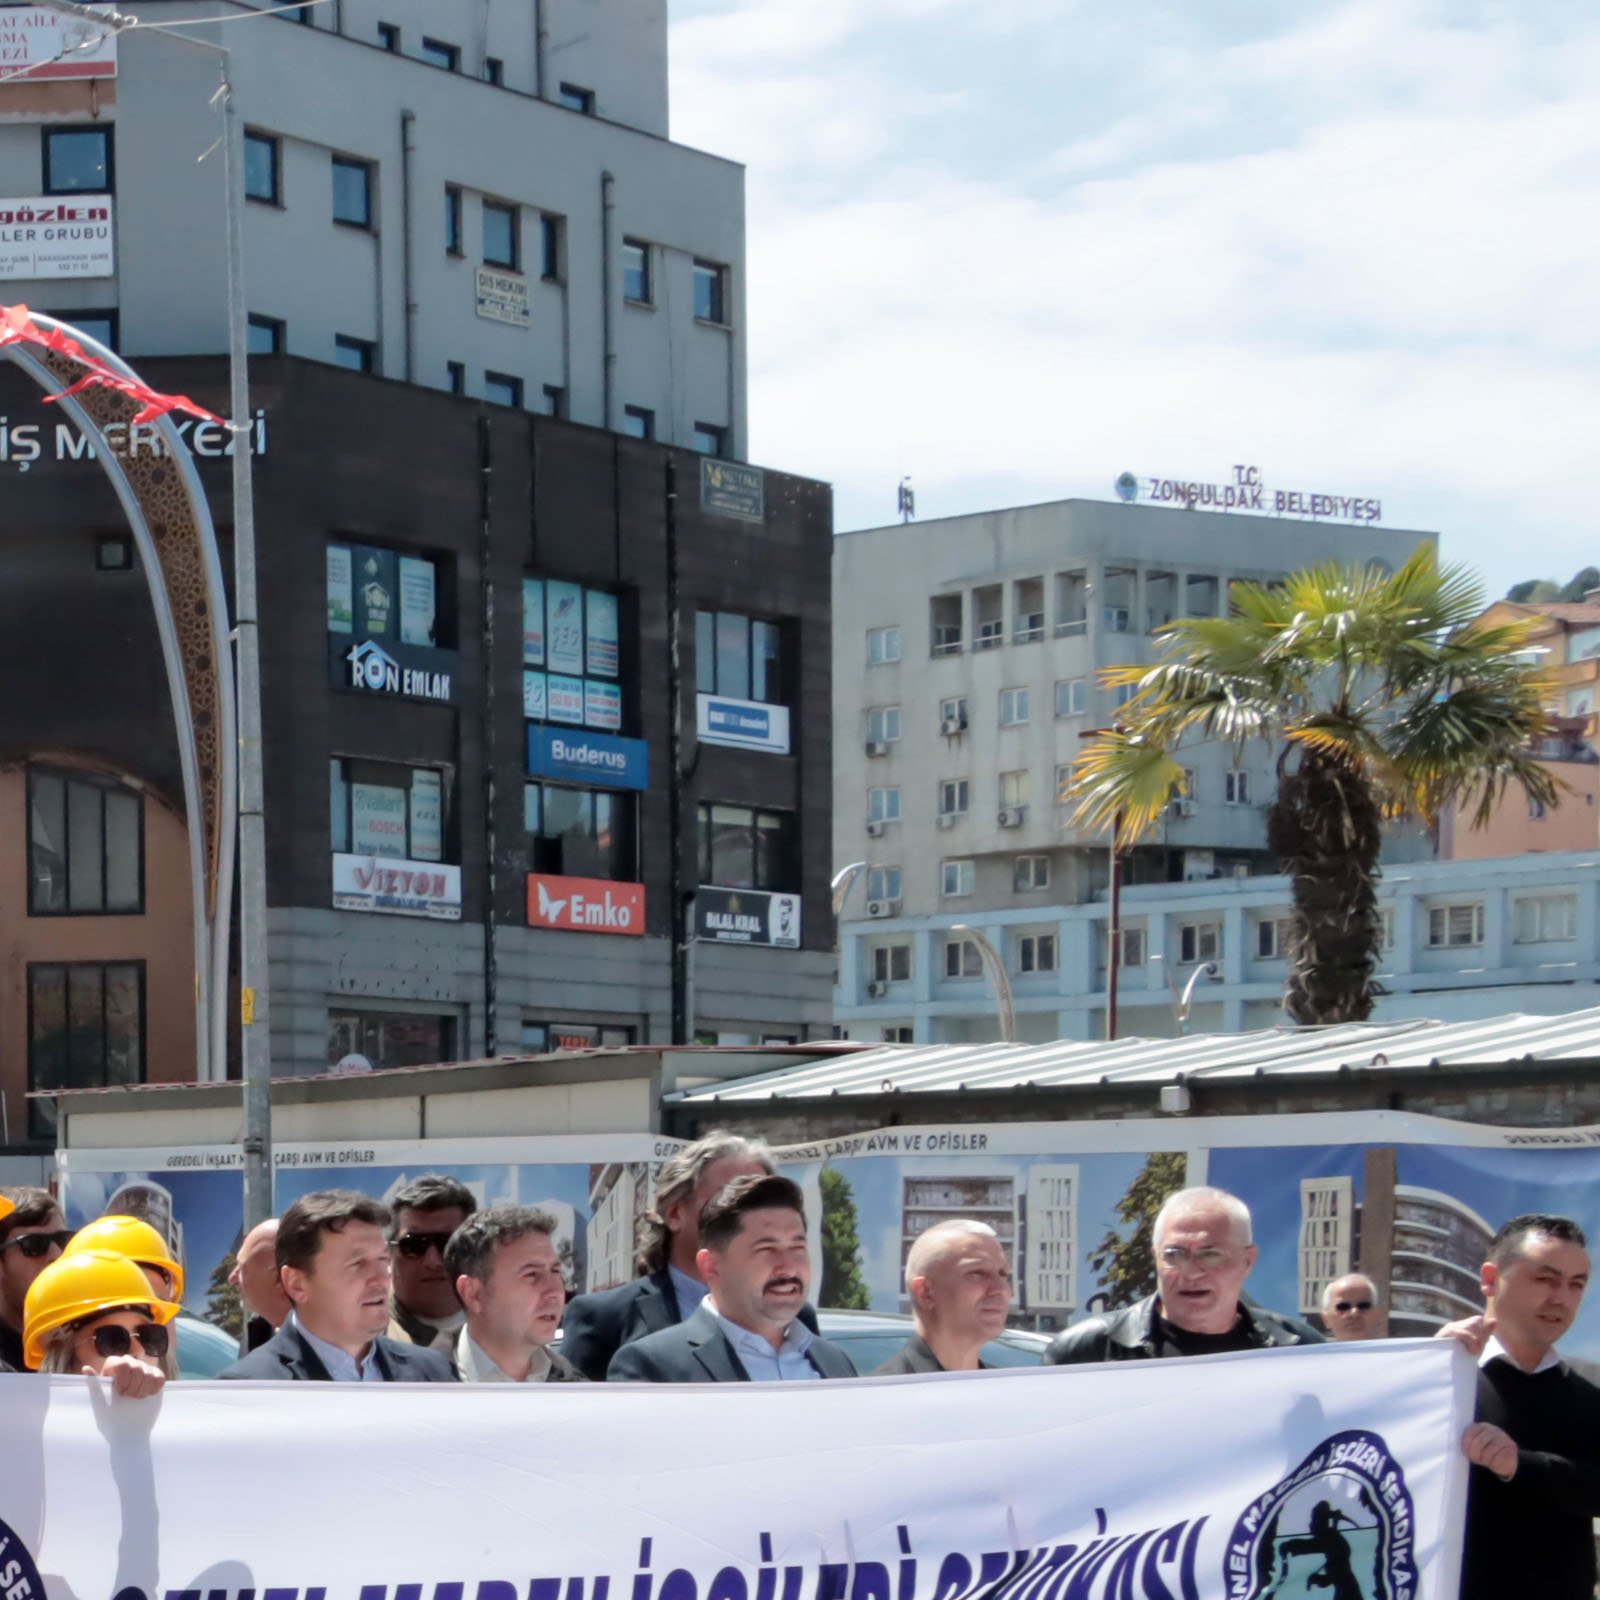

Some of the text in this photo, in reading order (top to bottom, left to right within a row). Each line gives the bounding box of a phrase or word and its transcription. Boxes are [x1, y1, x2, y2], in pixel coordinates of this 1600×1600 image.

[25, 12, 59, 28] AİLE
[44, 227, 108, 241] GRUBU
[0, 416, 41, 472] İŞ
[1149, 478, 1382, 521] ZONGULDAK BELEDİYESİ
[402, 668, 451, 701] EMLAK
[551, 738, 627, 769] Buderus
[570, 890, 631, 928] Emko
[866, 1134, 900, 1151] AVM
[902, 1134, 922, 1150] VE
[926, 1130, 988, 1150] OFİSLER
[166, 1148, 376, 1169] GEREDELİ İNŞAAT ÇARŞI AVM VE OFİSLER
